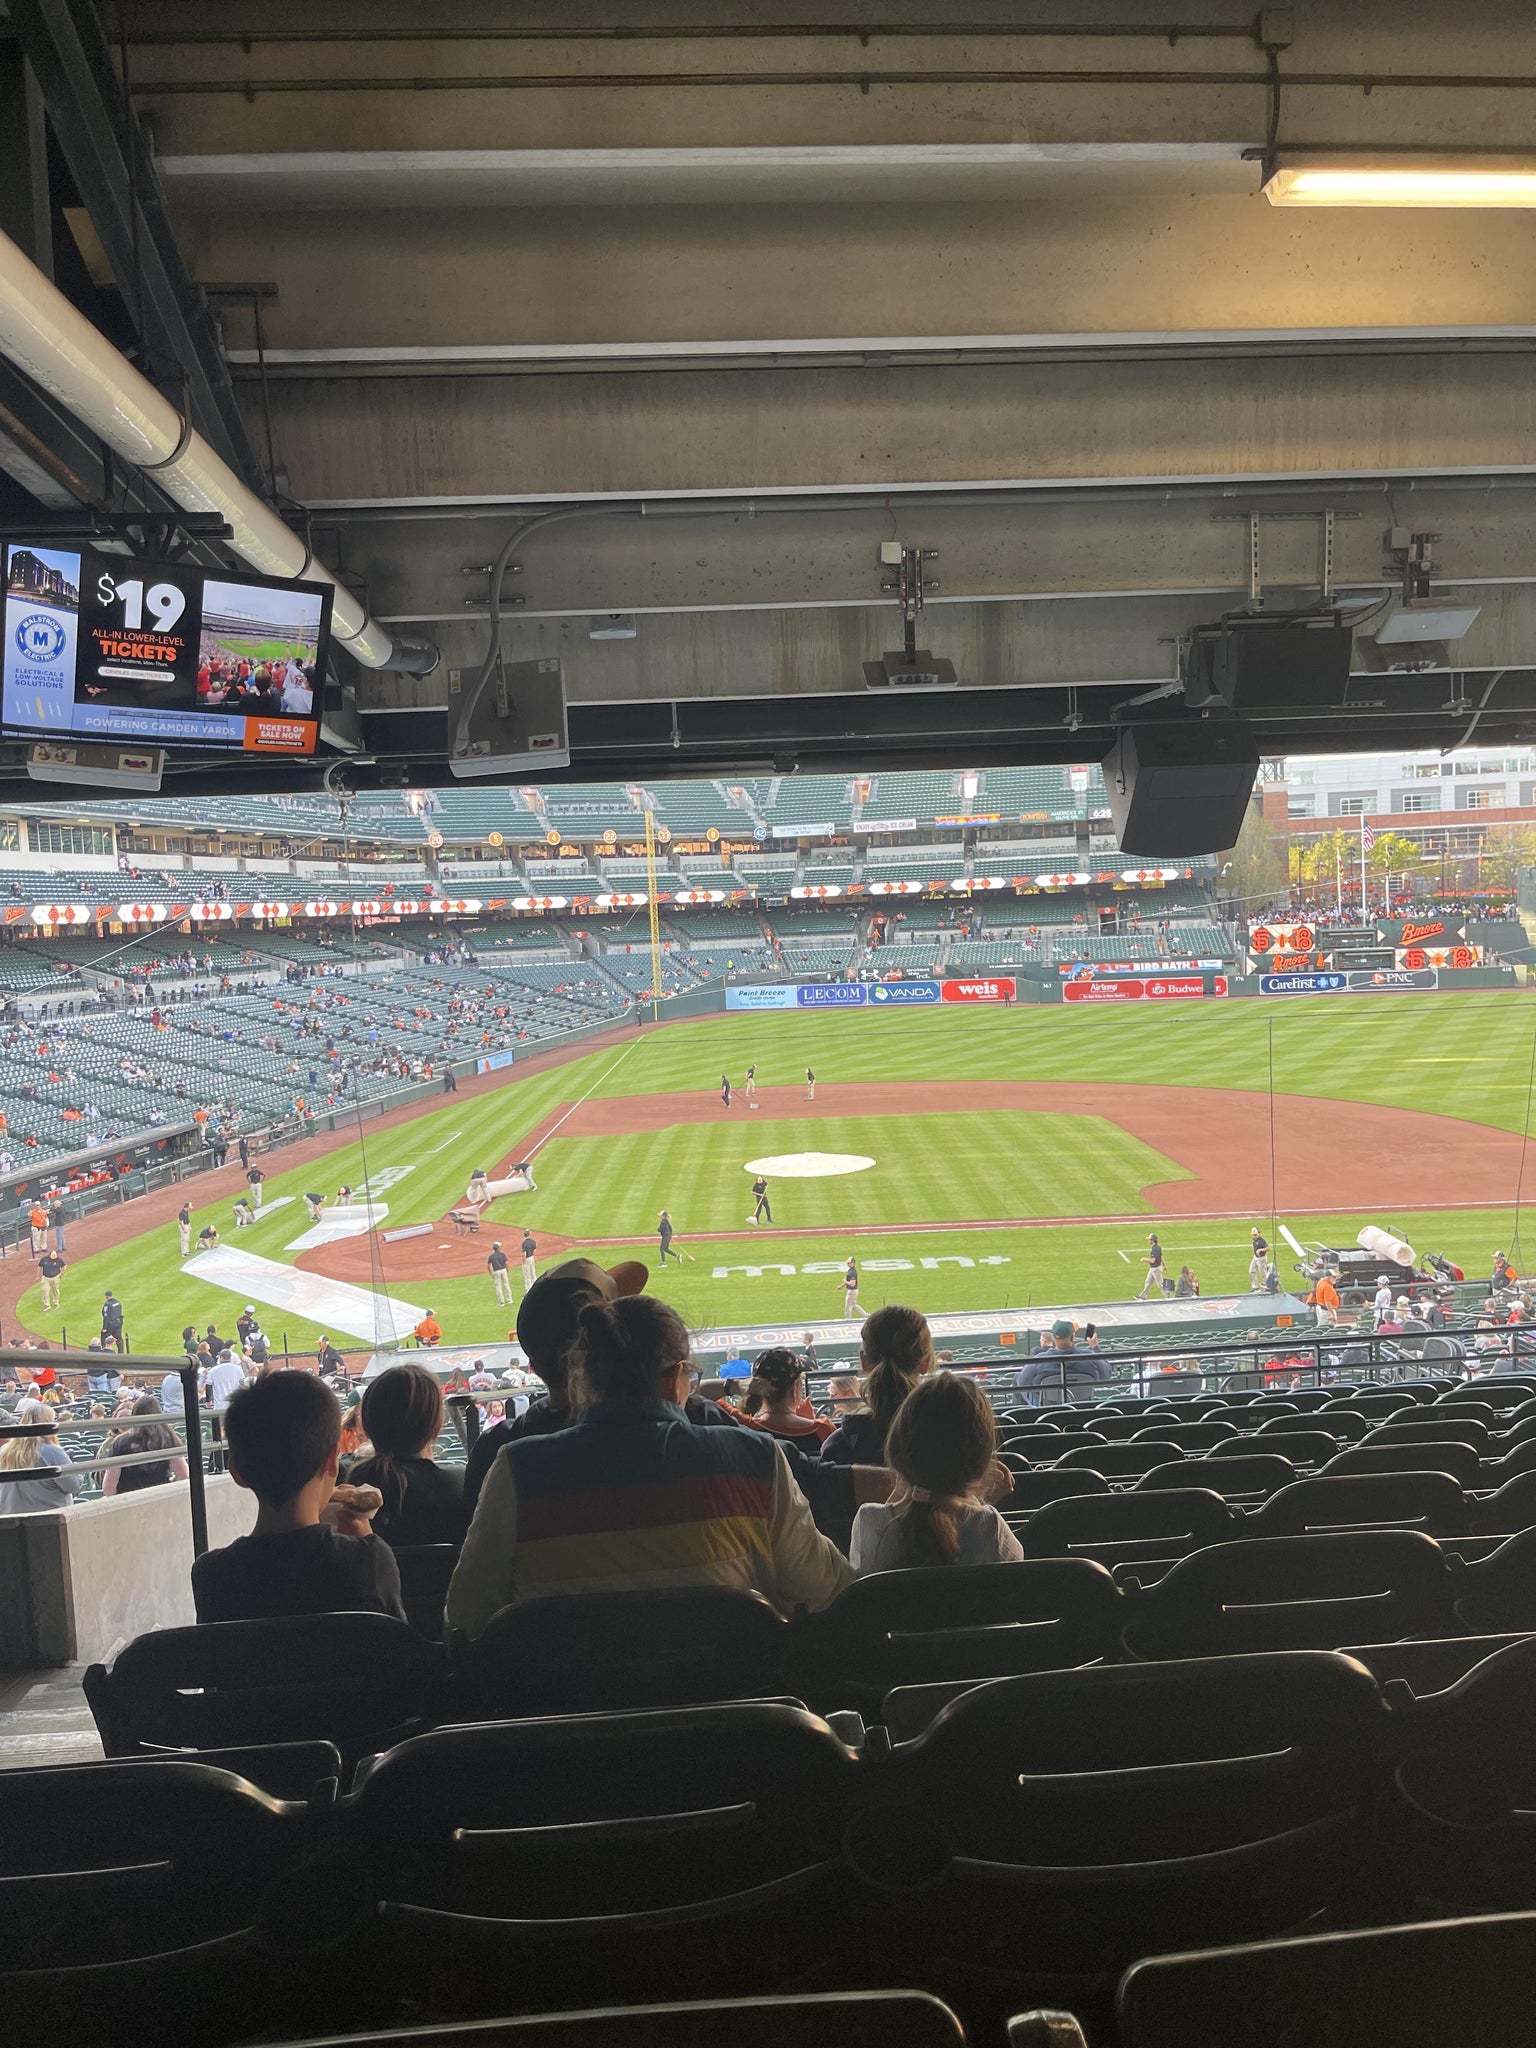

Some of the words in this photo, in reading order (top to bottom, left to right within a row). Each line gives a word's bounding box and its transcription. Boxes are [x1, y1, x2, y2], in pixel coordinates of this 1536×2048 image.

[97, 572, 186, 633] $19
[33, 631, 48, 647] M
[91, 628, 121, 640] ALL-IN
[123, 632, 185, 646] LOWER-LEVEL
[24, 648, 56, 660] ELECTRIC
[100, 639, 177, 662] TICKETS
[16, 667, 58, 677] ELECTRICAL
[15, 674, 64, 683] LOW-VOLTAGE
[15, 680, 64, 689] SOLUTIONS
[85, 717, 148, 731] POWERING
[151, 722, 198, 734] CAMDEN
[201, 725, 237, 737] YARDS
[258, 723, 291, 733] TICKETS
[260, 730, 280, 738] SALE
[605, 832, 615, 840] 22
[755, 829, 765, 837] 42
[431, 836, 441, 844] 20
[1398, 921, 1445, 946] Bmore
[1133, 962, 1159, 971] BIRD
[1162, 961, 1190, 970] BATH
[1386, 972, 1413, 983] PNC
[958, 981, 999, 995] weis
[1269, 978, 1317, 990] CareFirst
[803, 987, 861, 1000] LECOM
[888, 987, 934, 998] VANDA
[711, 1255, 1011, 1279] masn+
[694, 1333, 749, 1348] ME
[813, 1325, 863, 1340] TH
[927, 1313, 1057, 1332] RIOLES
